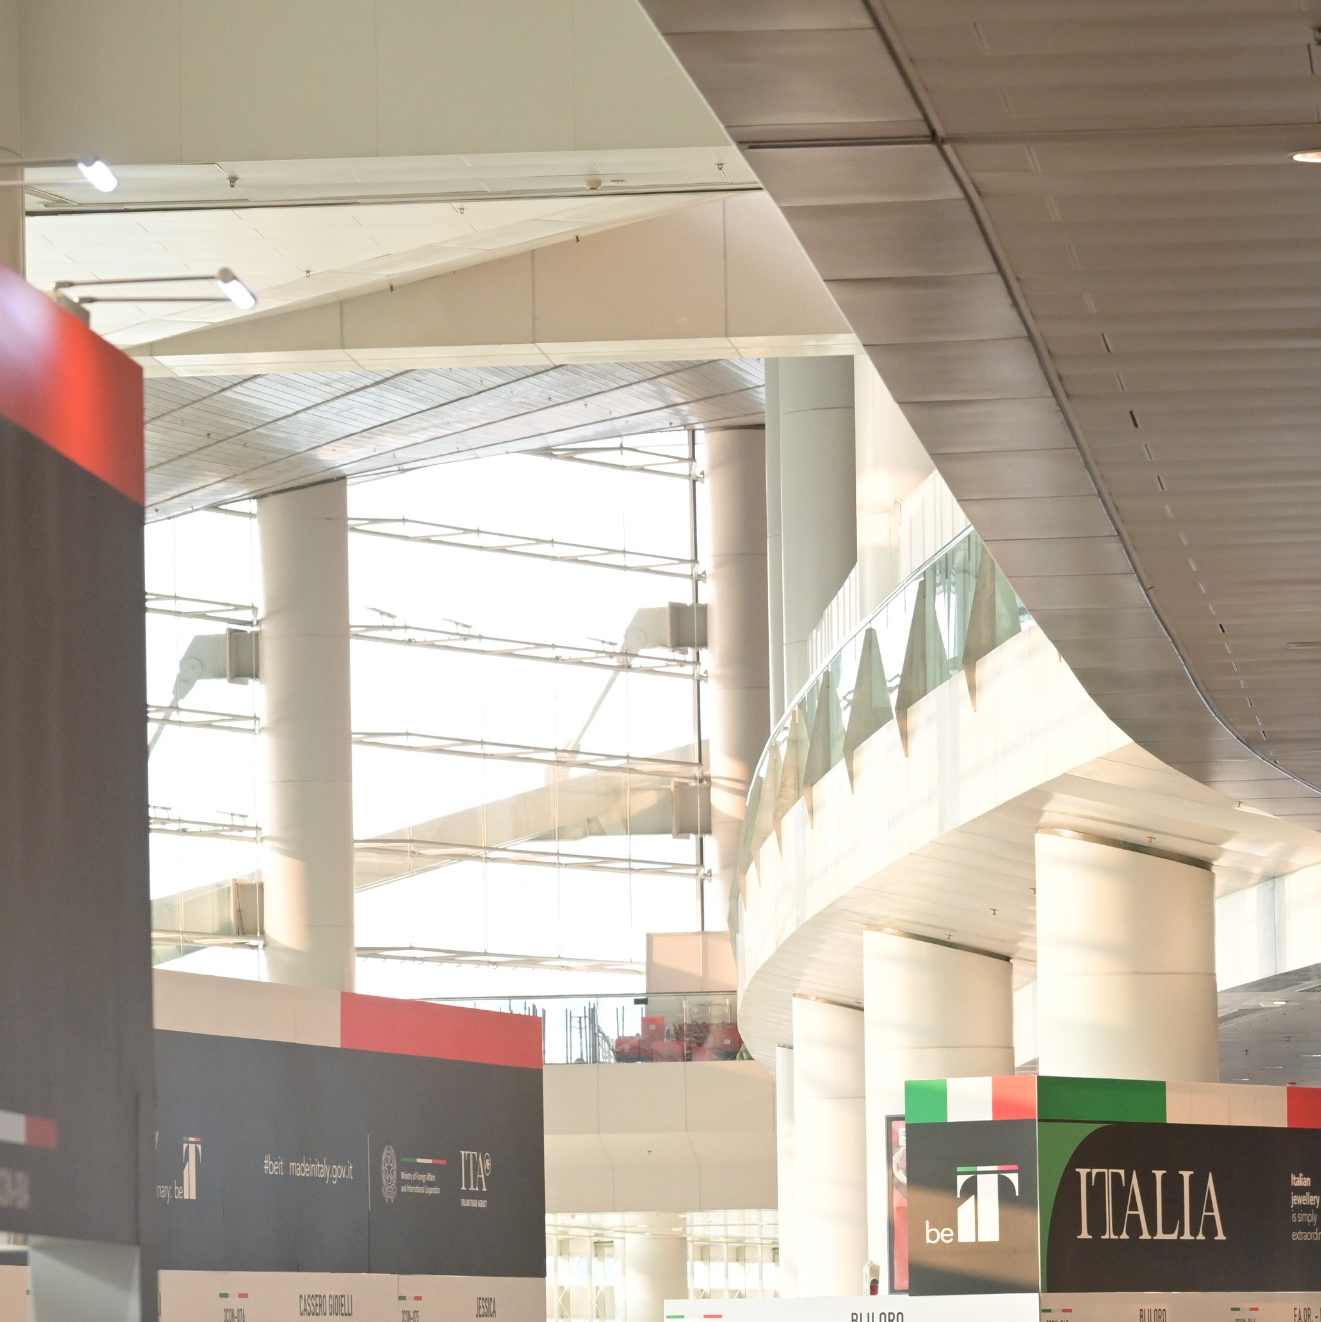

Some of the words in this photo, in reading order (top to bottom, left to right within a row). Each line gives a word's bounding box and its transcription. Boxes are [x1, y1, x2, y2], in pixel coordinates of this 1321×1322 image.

[263, 1154, 284, 1175] #beit
[289, 1156, 354, 1184] madeinitaly.gov.it
[1291, 1173, 1311, 1187] Italian
[1075, 1168, 1227, 1240] ITALIA
[1290, 1192, 1320, 1208] jewellery
[1297, 1209, 1317, 1226] simply
[223, 1308, 246, 1322] 3CON-076
[299, 1294, 327, 1317] CASSERO
[329, 1295, 353, 1317] GIOIELLI
[475, 1297, 497, 1318] JESSICA
